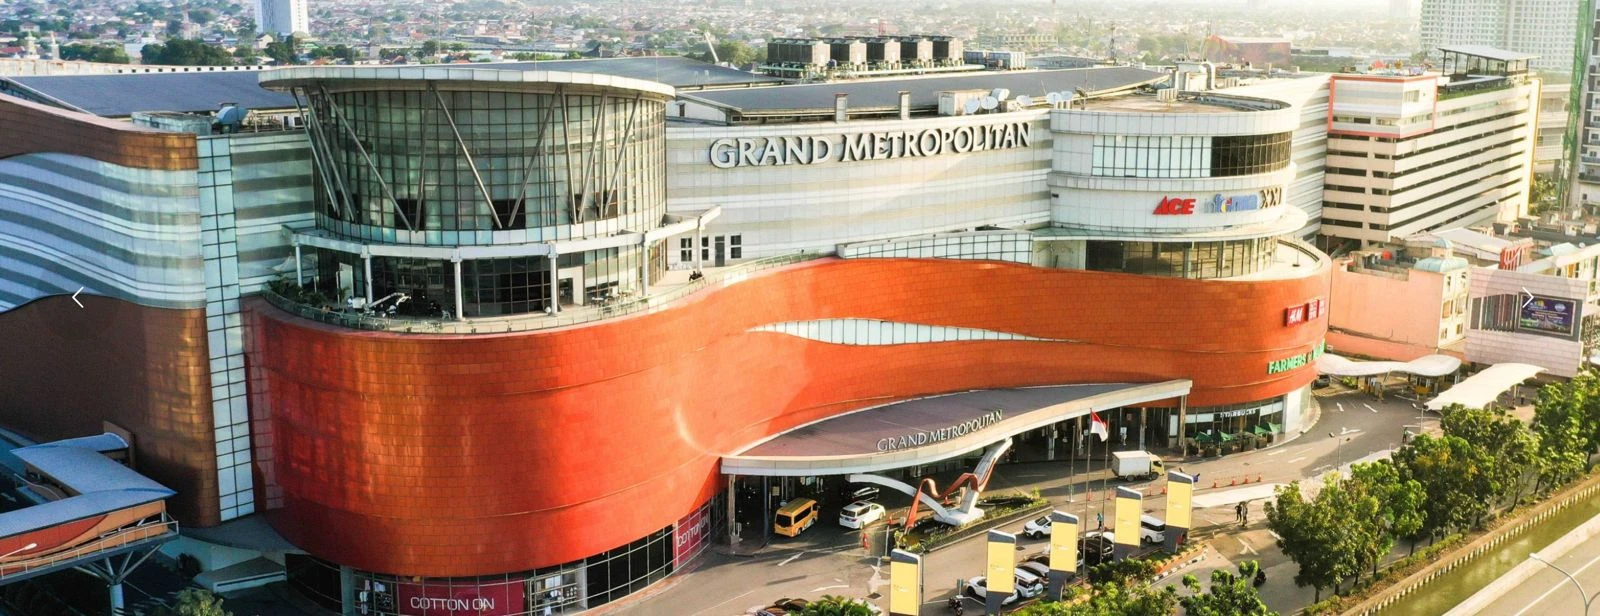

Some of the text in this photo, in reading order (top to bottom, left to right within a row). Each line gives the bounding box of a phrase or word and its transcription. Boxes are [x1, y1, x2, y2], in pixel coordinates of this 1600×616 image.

[709, 122, 1032, 169] GRAND METROPOLITAN
[1152, 195, 1196, 215] ACE
[1259, 187, 1282, 209] XXI
[1267, 353, 1306, 375] FARMERS
[877, 409, 1003, 451] GRAND METROPOLITAN
[410, 596, 495, 611] COTTON ON
